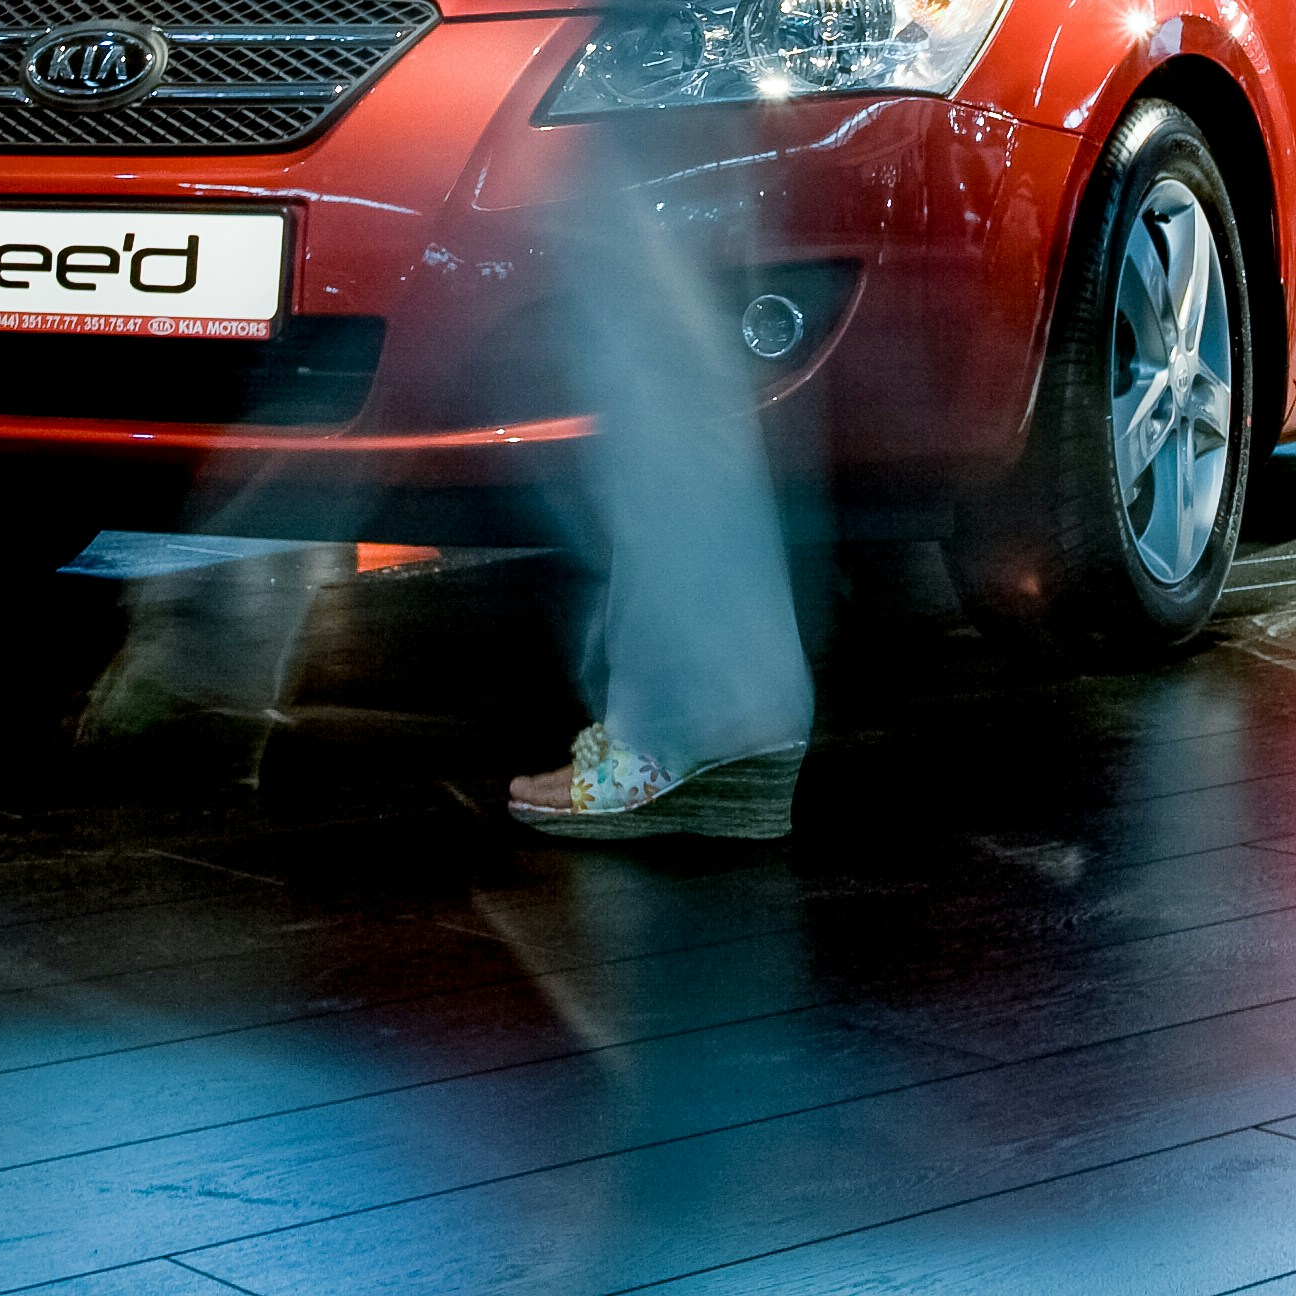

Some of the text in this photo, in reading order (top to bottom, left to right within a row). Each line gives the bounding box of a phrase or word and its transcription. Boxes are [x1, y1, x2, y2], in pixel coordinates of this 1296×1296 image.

[47, 44, 129, 81] KIA
[178, 319, 204, 334] KIA
[206, 320, 268, 337] MOTORS
